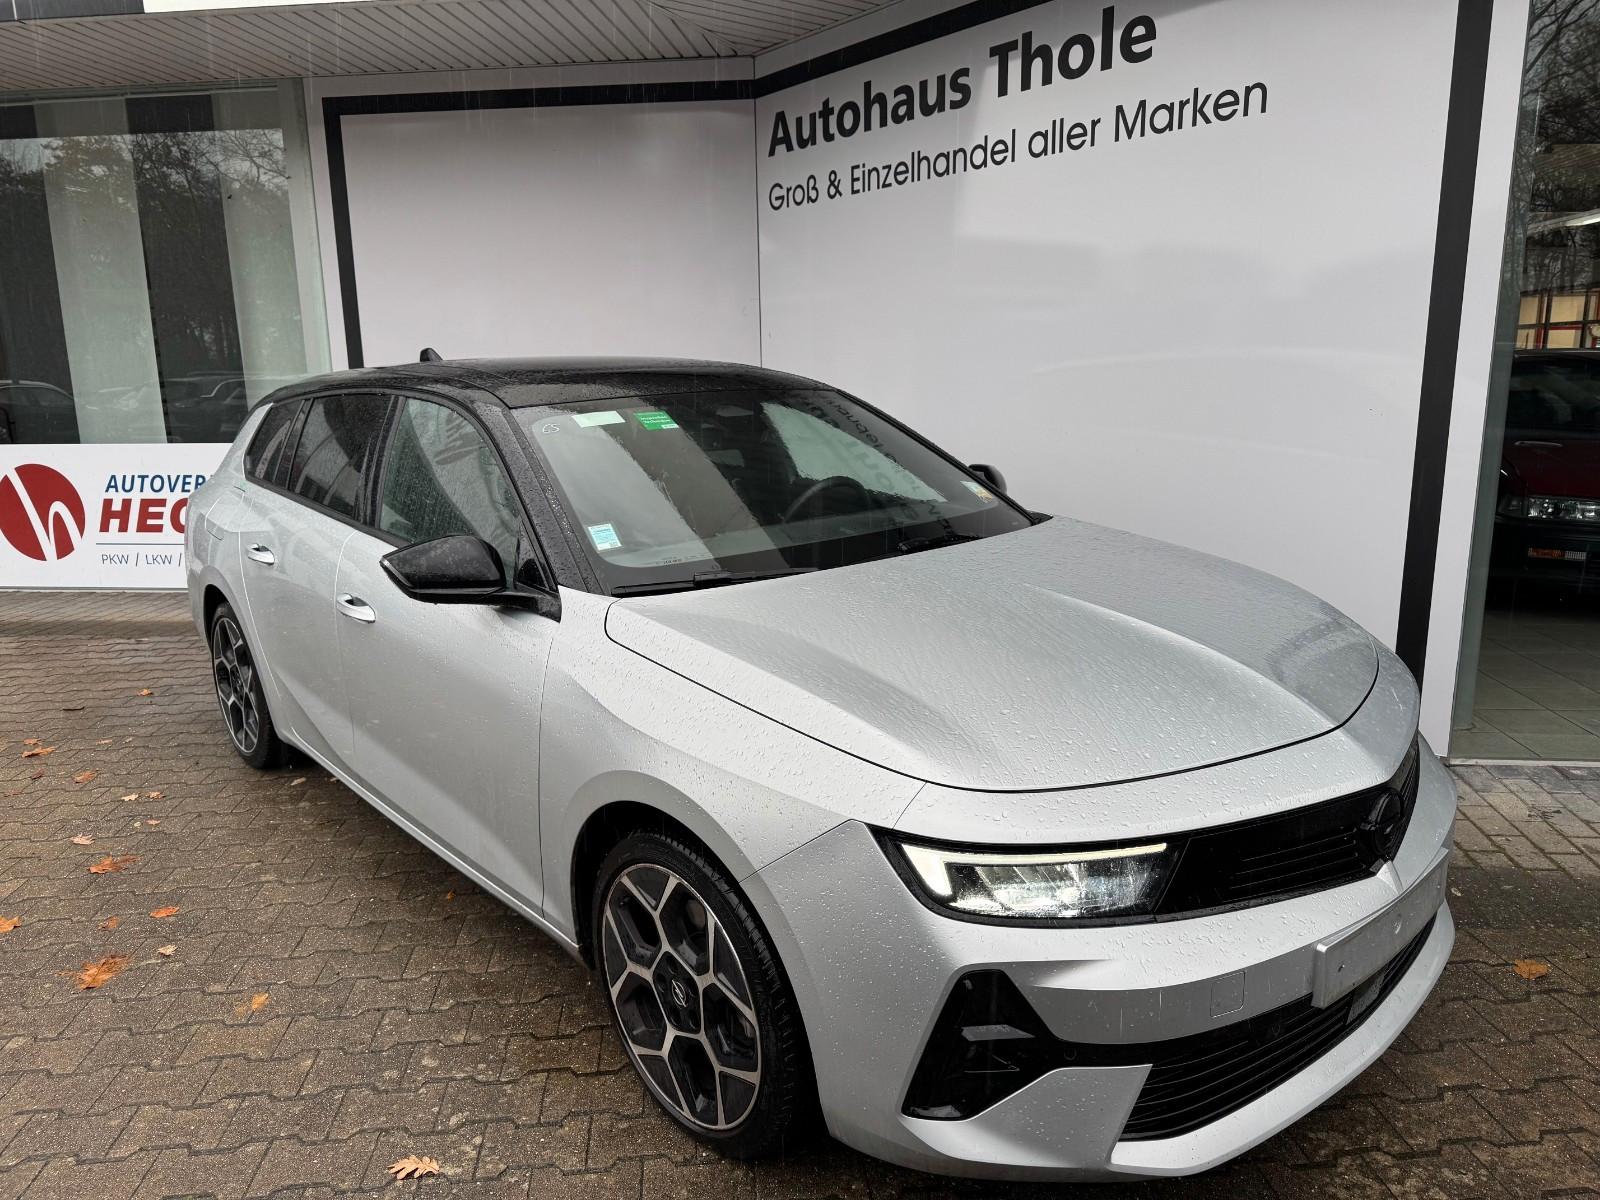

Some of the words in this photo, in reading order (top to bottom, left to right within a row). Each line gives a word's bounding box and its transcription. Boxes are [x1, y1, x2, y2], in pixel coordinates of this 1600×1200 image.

[768, 67, 972, 158] Autohaus
[989, 4, 1157, 98] Thole
[768, 174, 820, 211] Groß
[826, 169, 843, 200] &
[850, 129, 1017, 196] Einzelhandel
[1027, 116, 1102, 158] aller
[1114, 82, 1268, 143] Marken
[105, 474, 214, 493] AUTOVER
[101, 553, 129, 565] PKW
[145, 553, 173, 565] LKW
